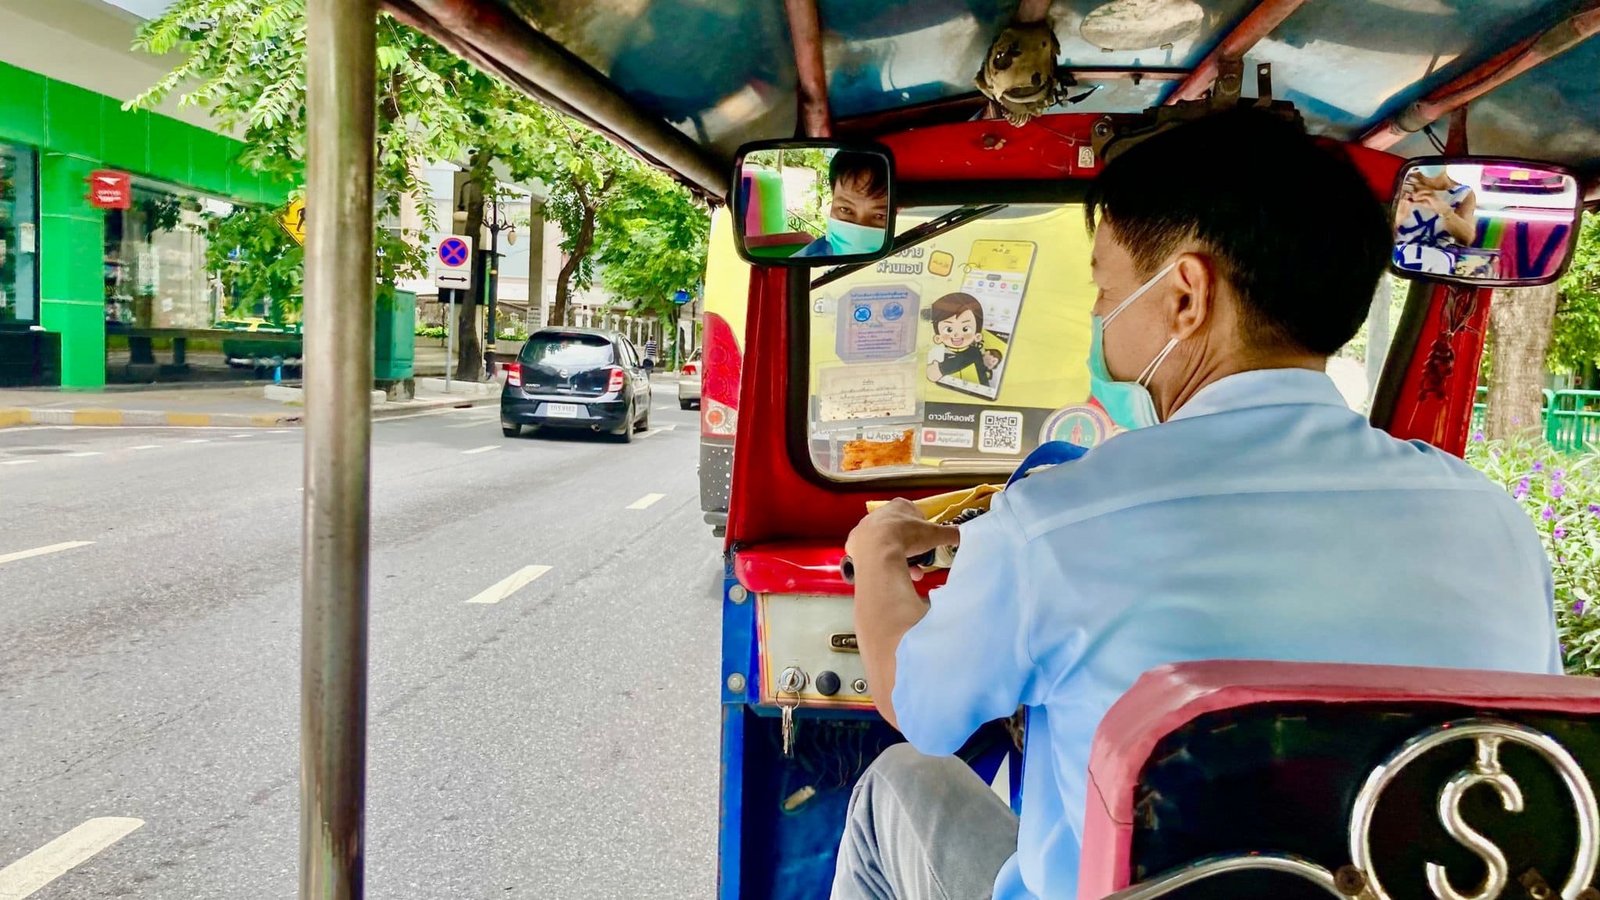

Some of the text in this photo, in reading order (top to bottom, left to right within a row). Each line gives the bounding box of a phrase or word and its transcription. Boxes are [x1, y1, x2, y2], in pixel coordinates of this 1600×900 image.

[876, 260, 923, 274] ผ่านแอป
[928, 411, 976, 423] ดาวน์โหลดฟรี
[875, 431, 891, 441] App
